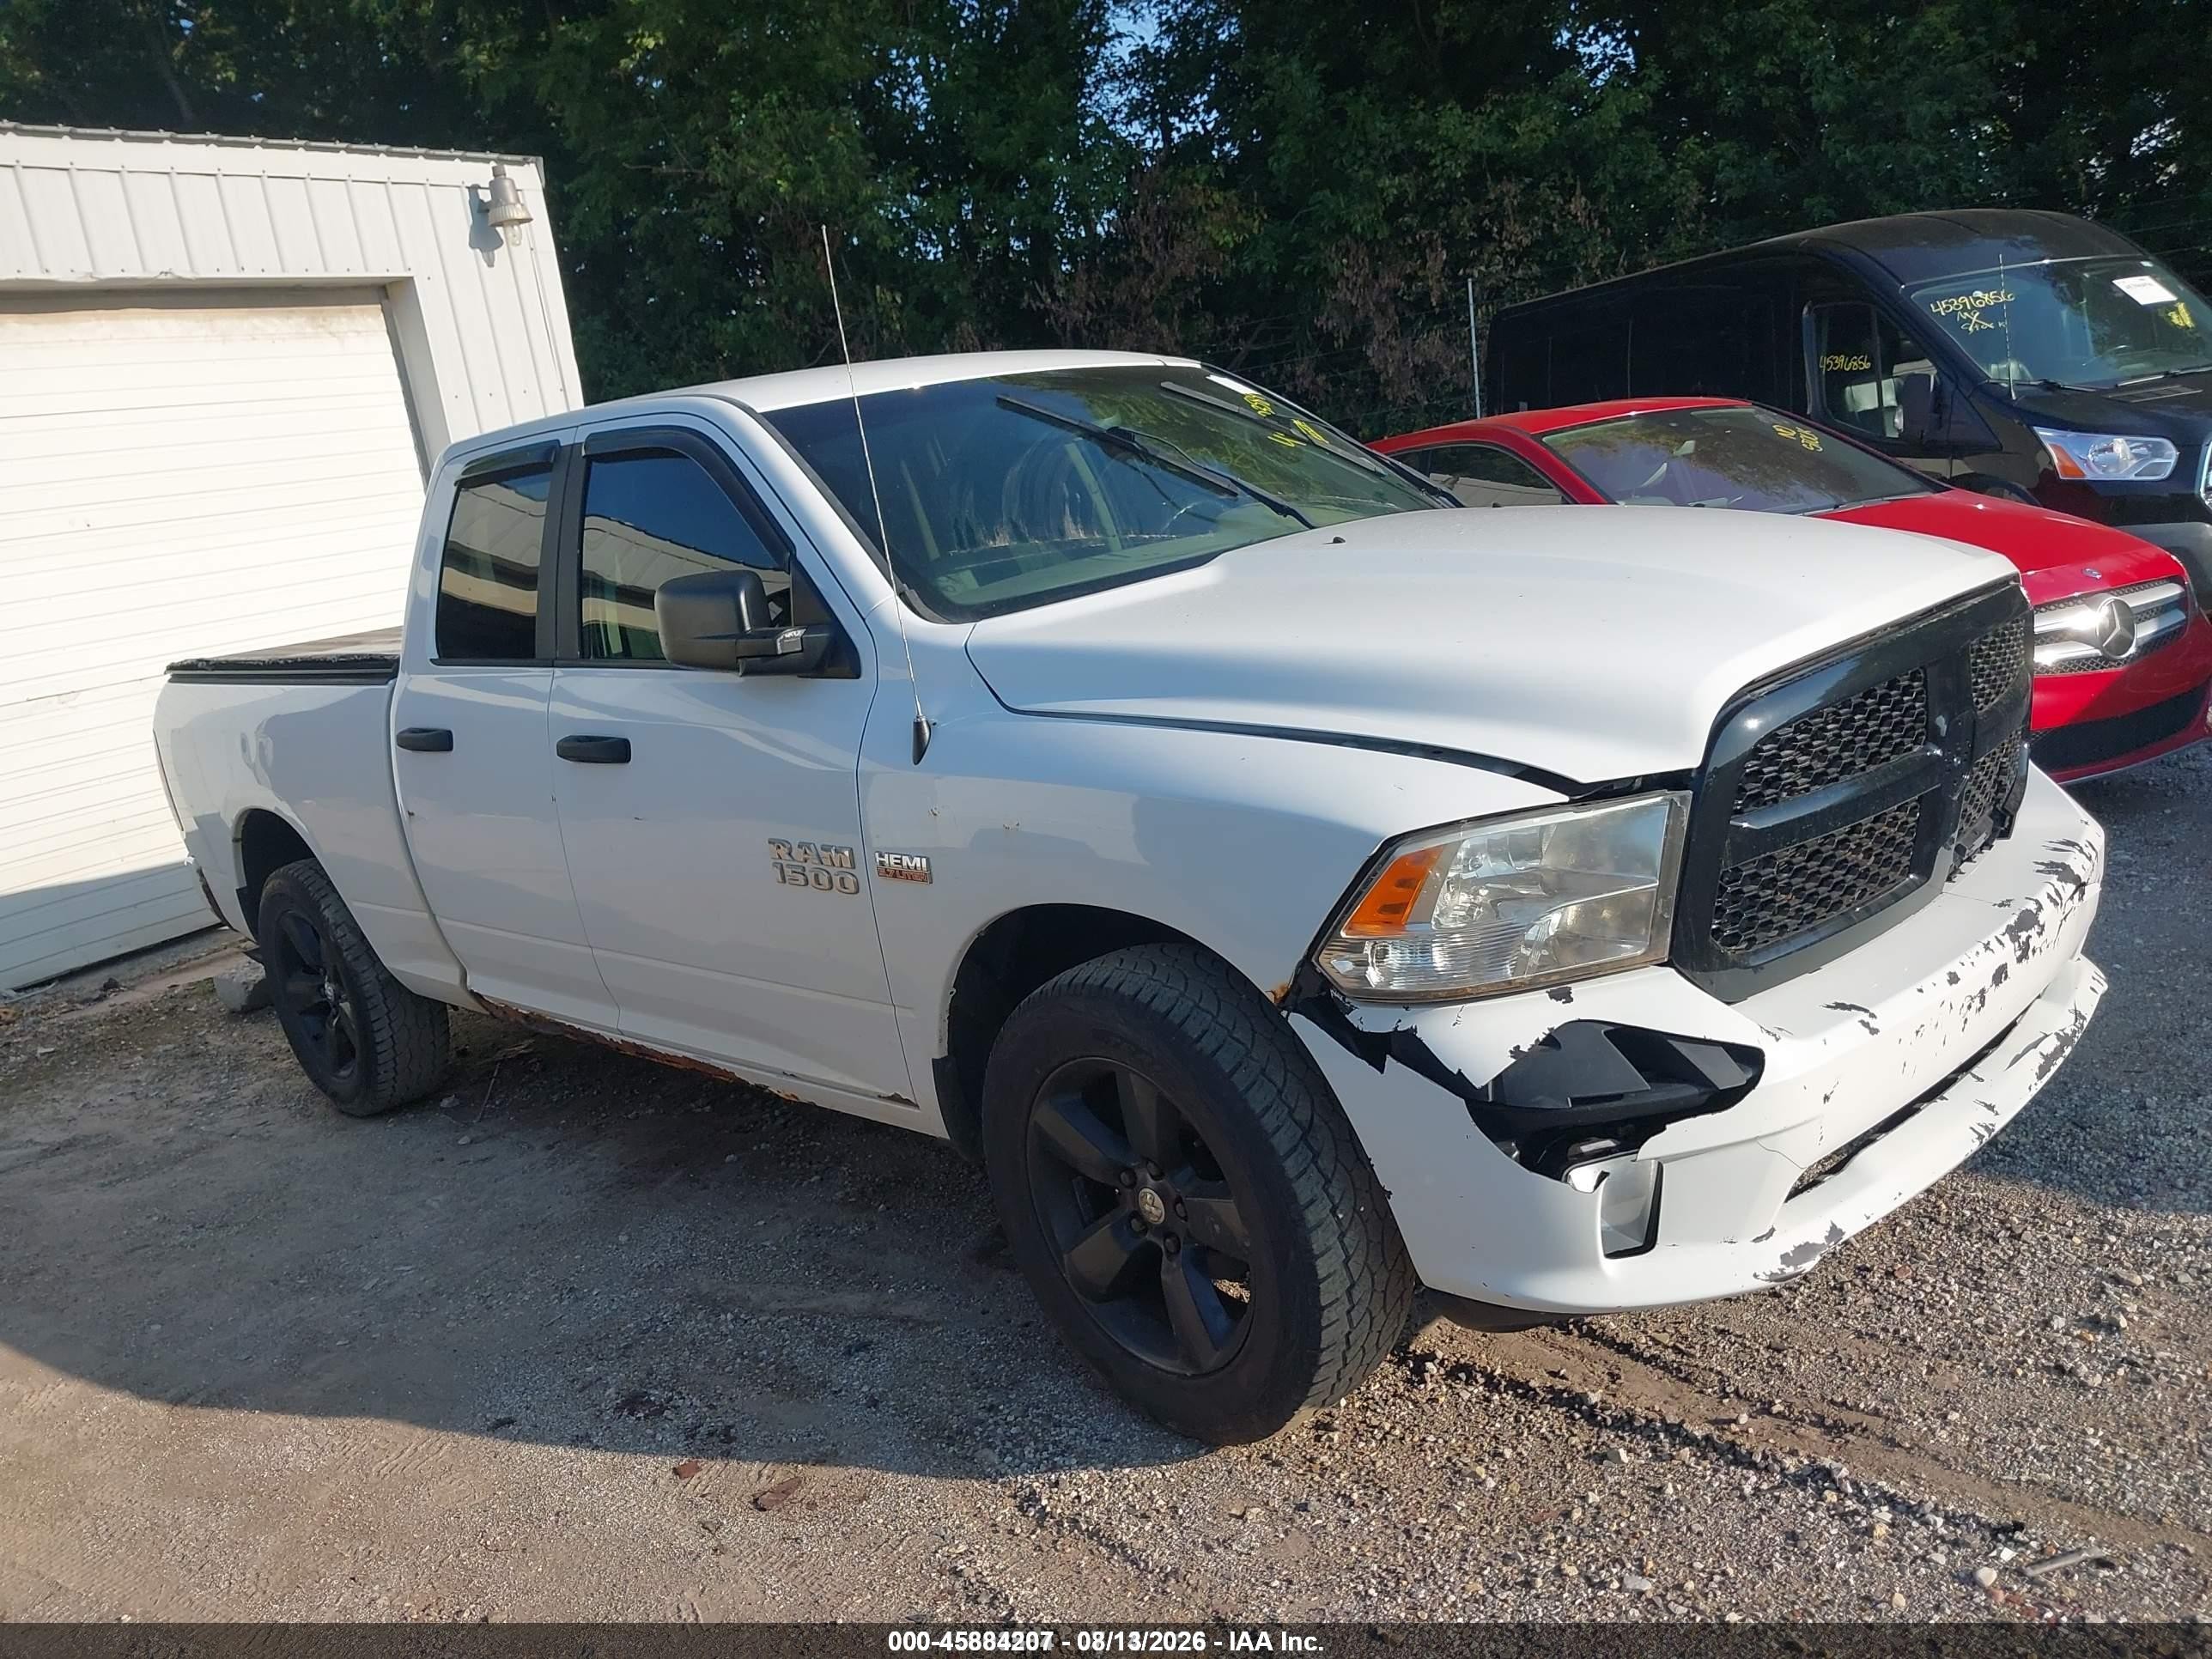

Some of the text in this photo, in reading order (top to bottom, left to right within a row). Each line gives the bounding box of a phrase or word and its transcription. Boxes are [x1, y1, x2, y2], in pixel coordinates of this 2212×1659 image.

[1819, 354, 1872, 375] 45396856
[769, 838, 855, 869] RAM
[874, 851, 930, 872] HEMI
[772, 862, 859, 895] 1500
